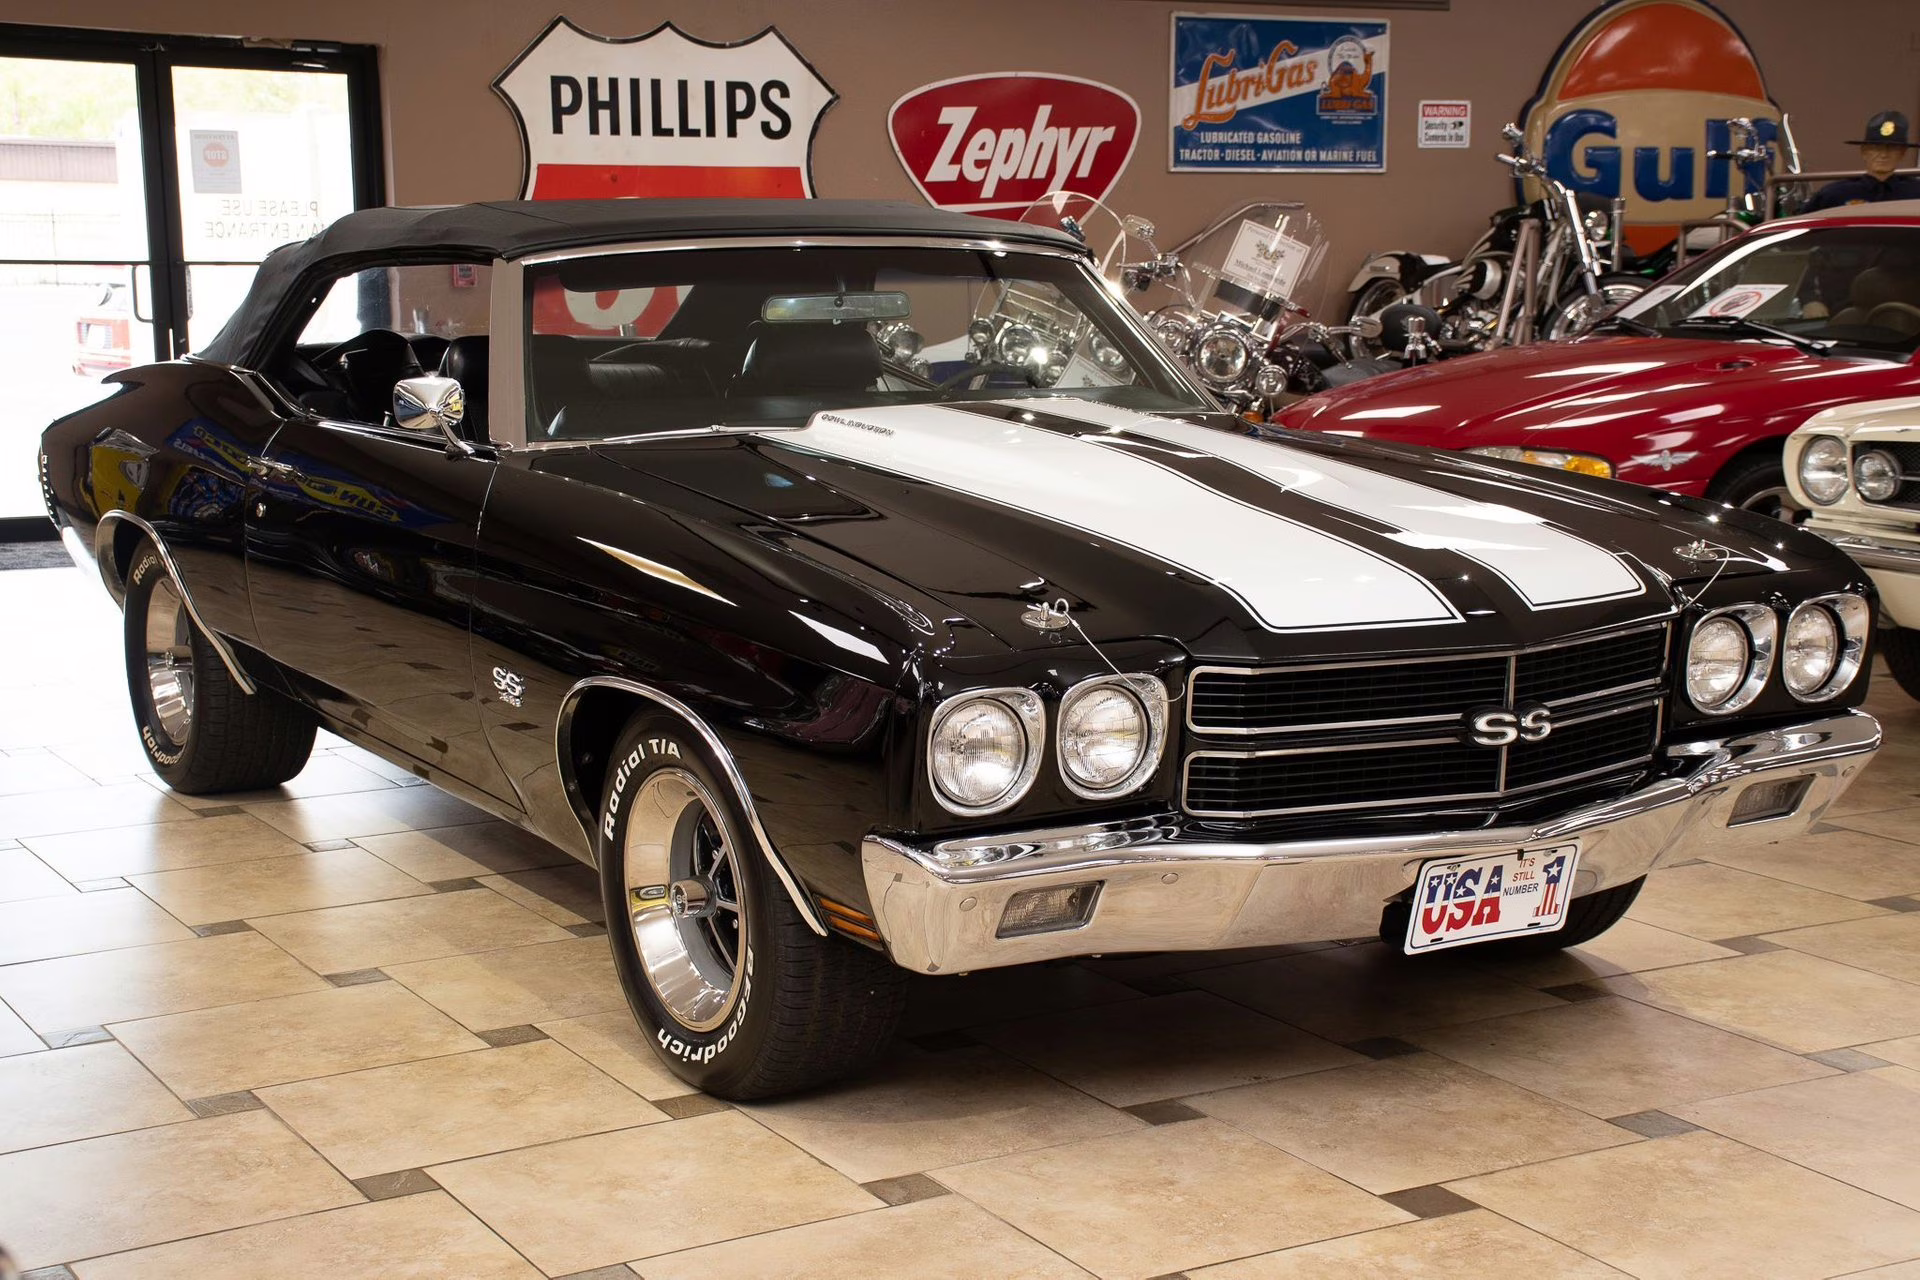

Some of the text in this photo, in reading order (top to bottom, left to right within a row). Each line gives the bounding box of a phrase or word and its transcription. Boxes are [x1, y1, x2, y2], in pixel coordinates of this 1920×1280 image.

[550, 75, 792, 140] PHILLIPS
[1423, 105, 1467, 117] WARNING
[1200, 131, 1302, 144] LUBRICATED GASOLINE
[925, 104, 1117, 204] Zephyr
[1304, 150, 1318, 161] OR
[1319, 150, 1354, 162] MARINE
[1356, 151, 1377, 162] FUEL
[1544, 108, 1780, 202] Gulf
[133, 553, 159, 586] Radial
[492, 666, 523, 697] SS
[1473, 706, 1552, 746] SS
[604, 743, 646, 842] Radial
[1512, 870, 1536, 883] STILL
[1518, 857, 1536, 868] IT'S
[1421, 855, 1567, 935] USA 1
[1502, 882, 1539, 897] NUMBER
